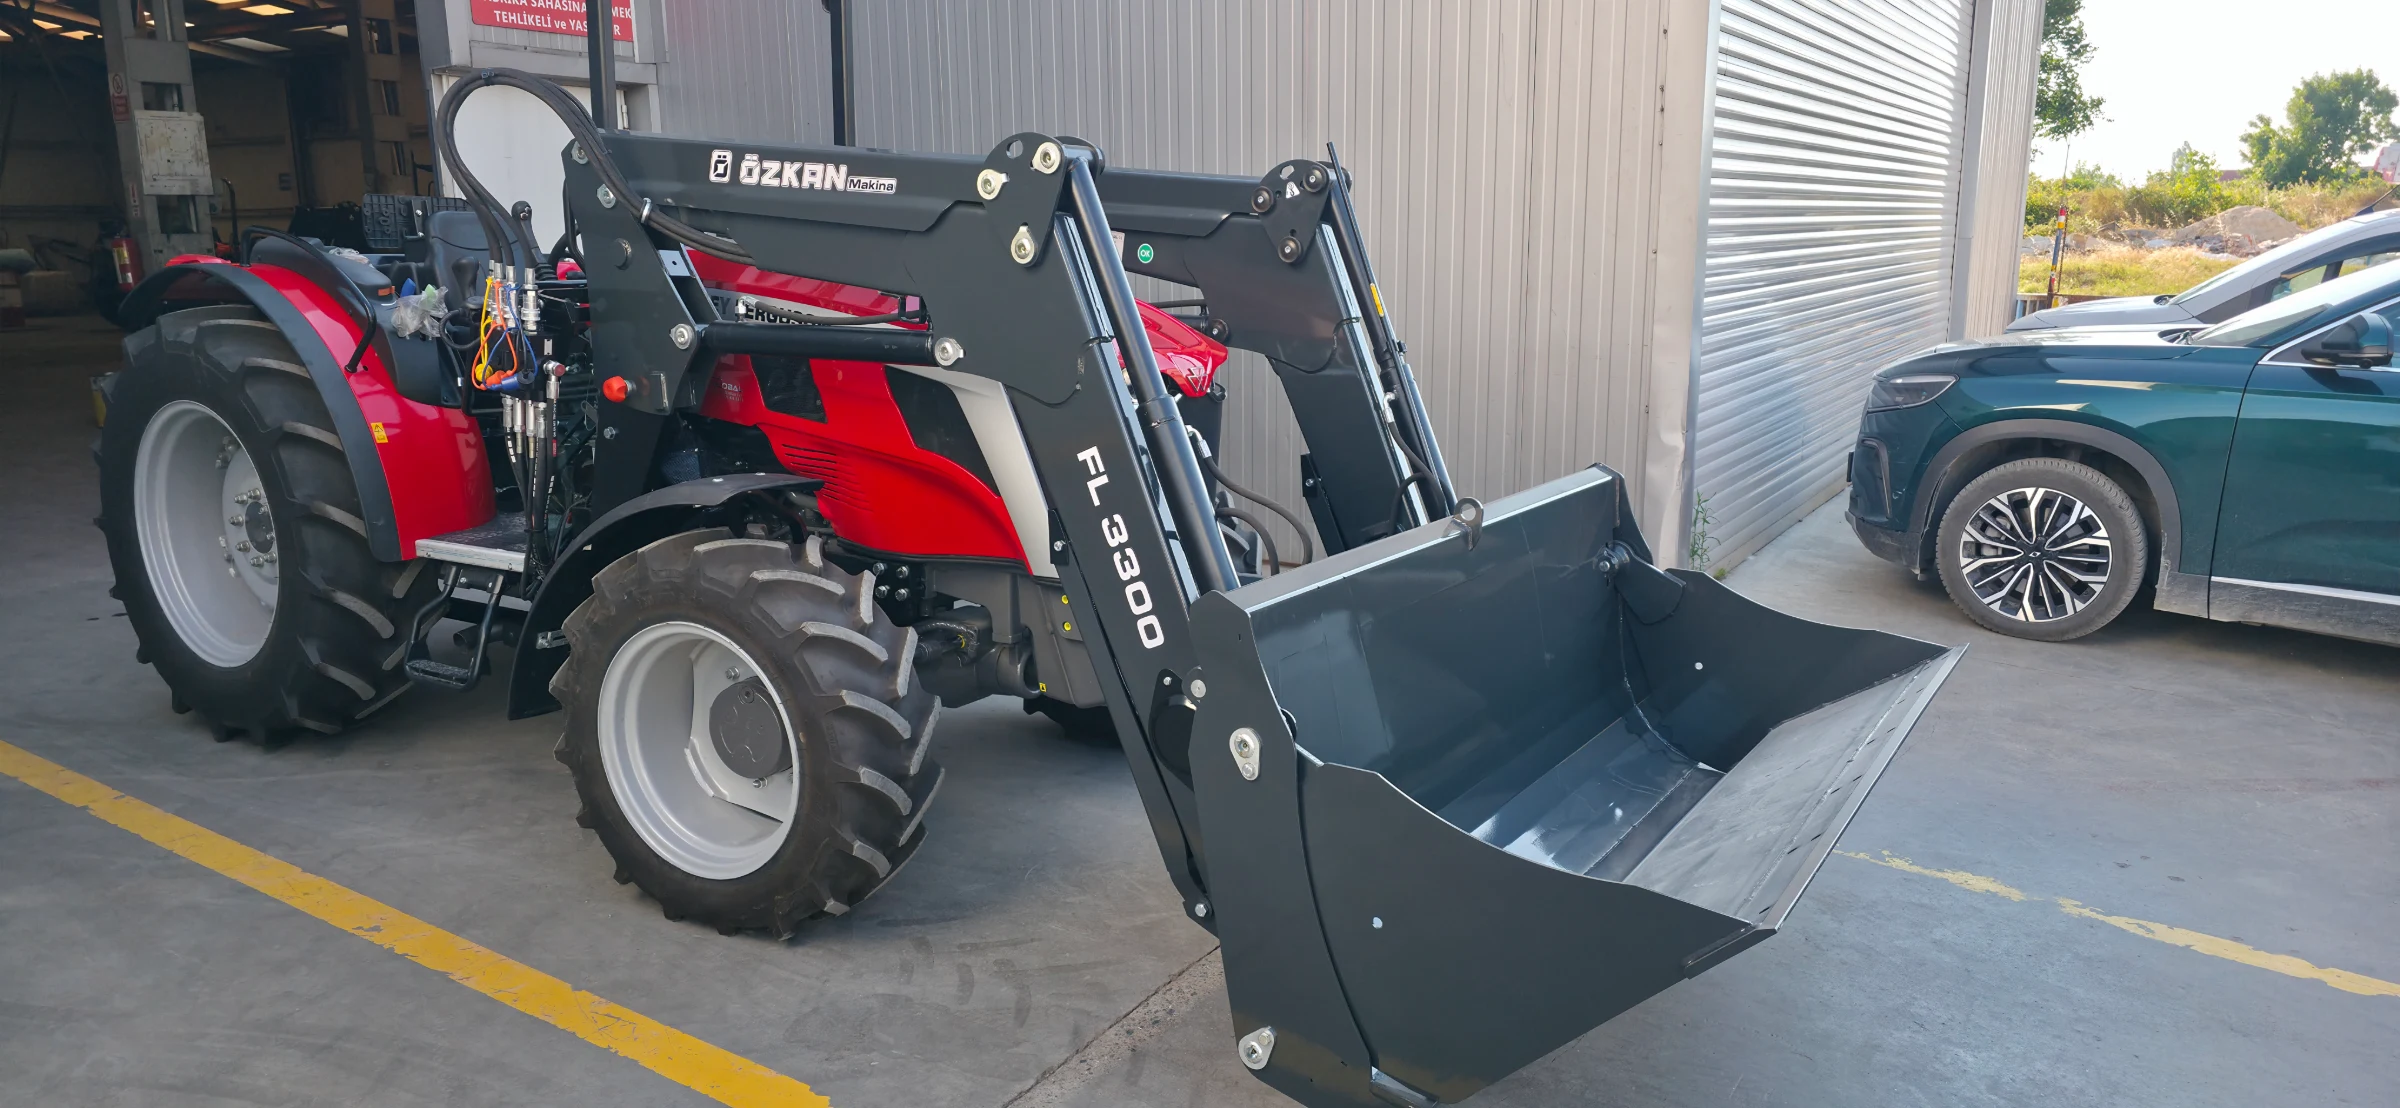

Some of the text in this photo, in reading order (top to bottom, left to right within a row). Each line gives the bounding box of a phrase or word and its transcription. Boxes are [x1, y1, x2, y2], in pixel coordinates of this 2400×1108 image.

[494, 10, 552, 28] TEHLİKELİ
[554, 20, 567, 29] ve
[739, 154, 894, 192] ÖZKAN Makina
[1140, 249, 1151, 258] OK
[1077, 445, 1165, 649] FL 3300
